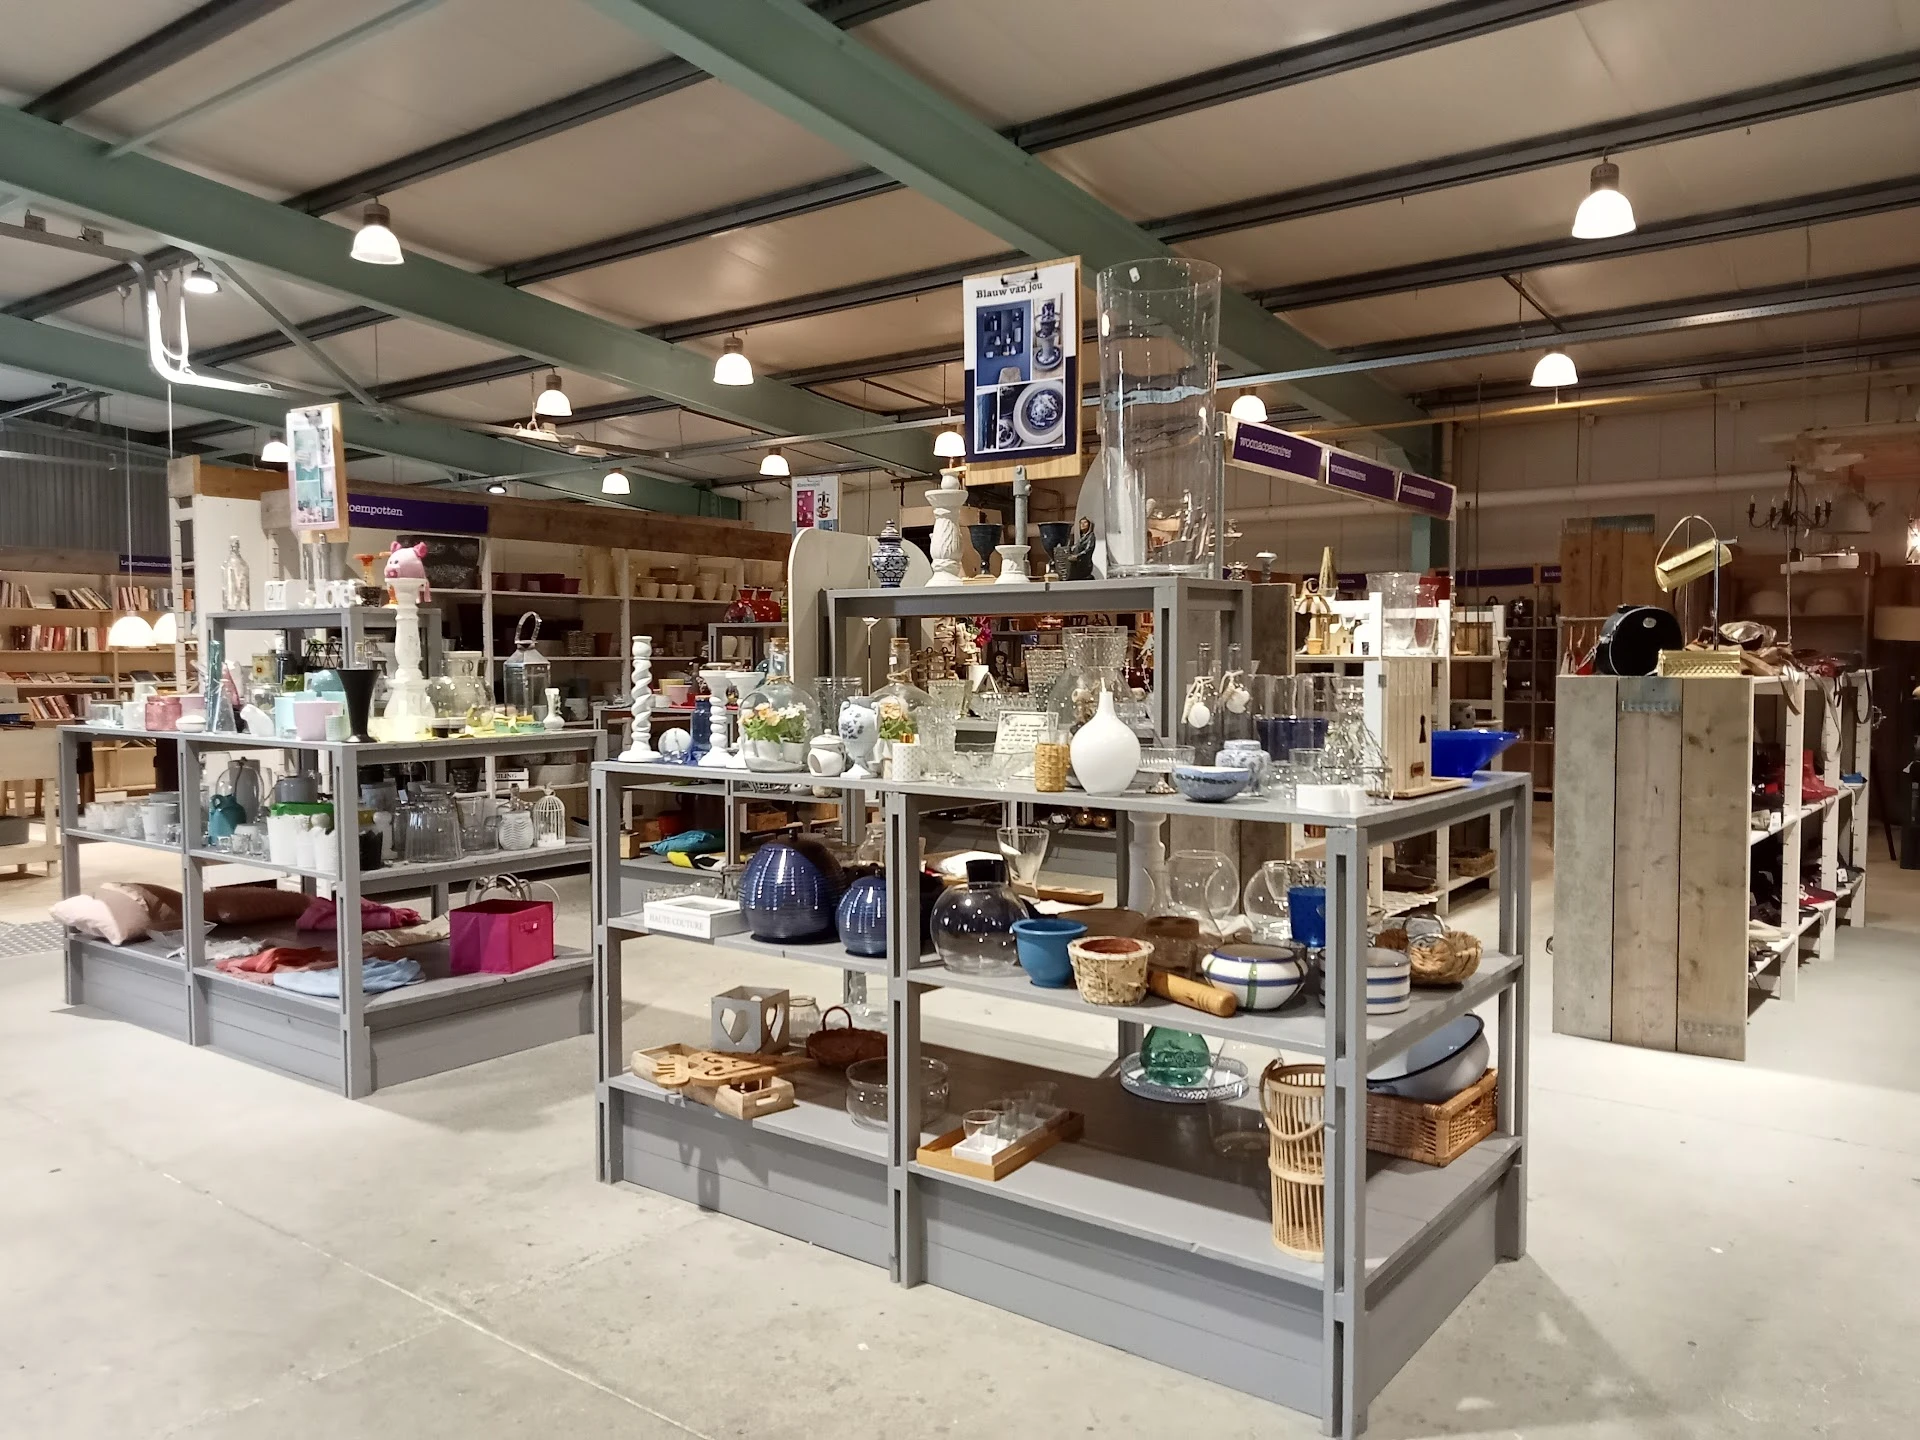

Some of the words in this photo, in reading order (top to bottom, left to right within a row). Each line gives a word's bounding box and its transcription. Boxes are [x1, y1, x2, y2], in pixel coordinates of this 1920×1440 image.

[976, 289, 1007, 298] Blauw
[1009, 285, 1027, 294] van
[1028, 281, 1043, 293] jou
[347, 503, 404, 517] oempotten
